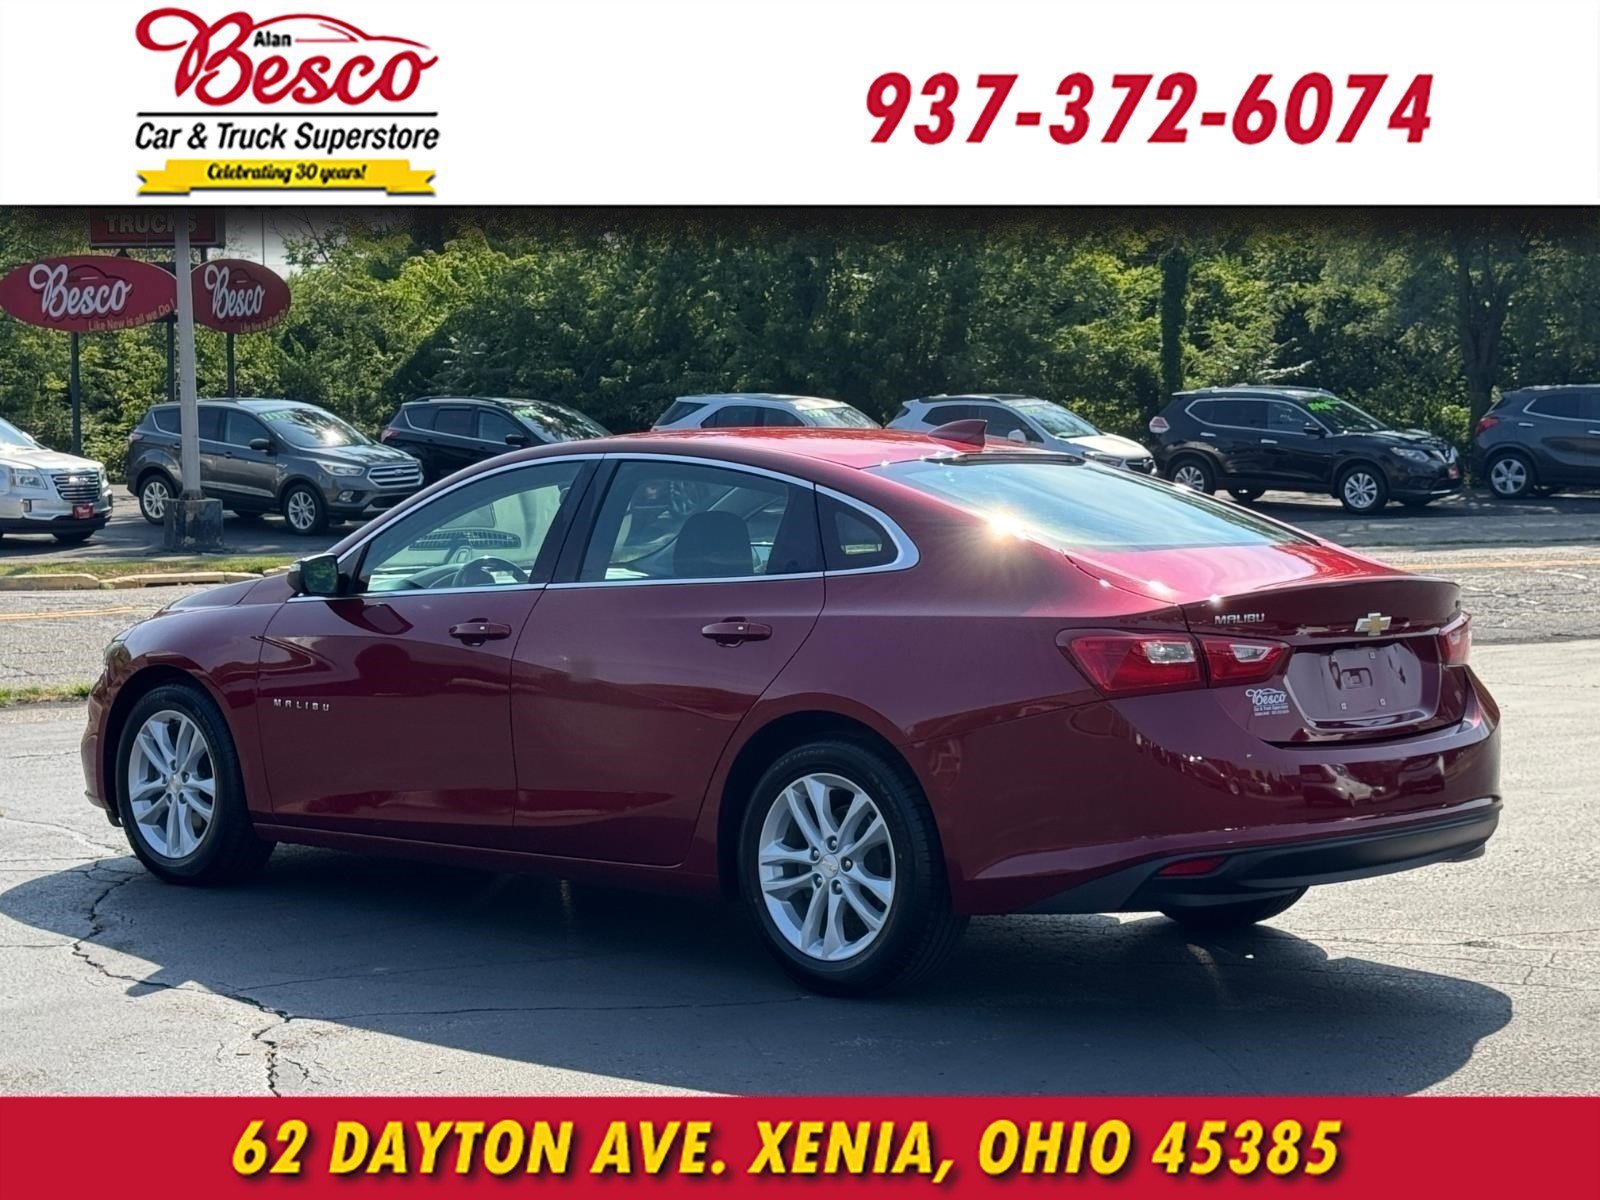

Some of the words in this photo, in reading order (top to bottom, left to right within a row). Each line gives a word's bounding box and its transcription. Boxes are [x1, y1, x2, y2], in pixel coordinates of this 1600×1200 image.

[29, 264, 132, 317] Besco
[204, 264, 265, 319] Besco
[1214, 613, 1265, 624] MALIBU
[273, 698, 330, 711] MALIBU
[1245, 689, 1287, 705] Besco
